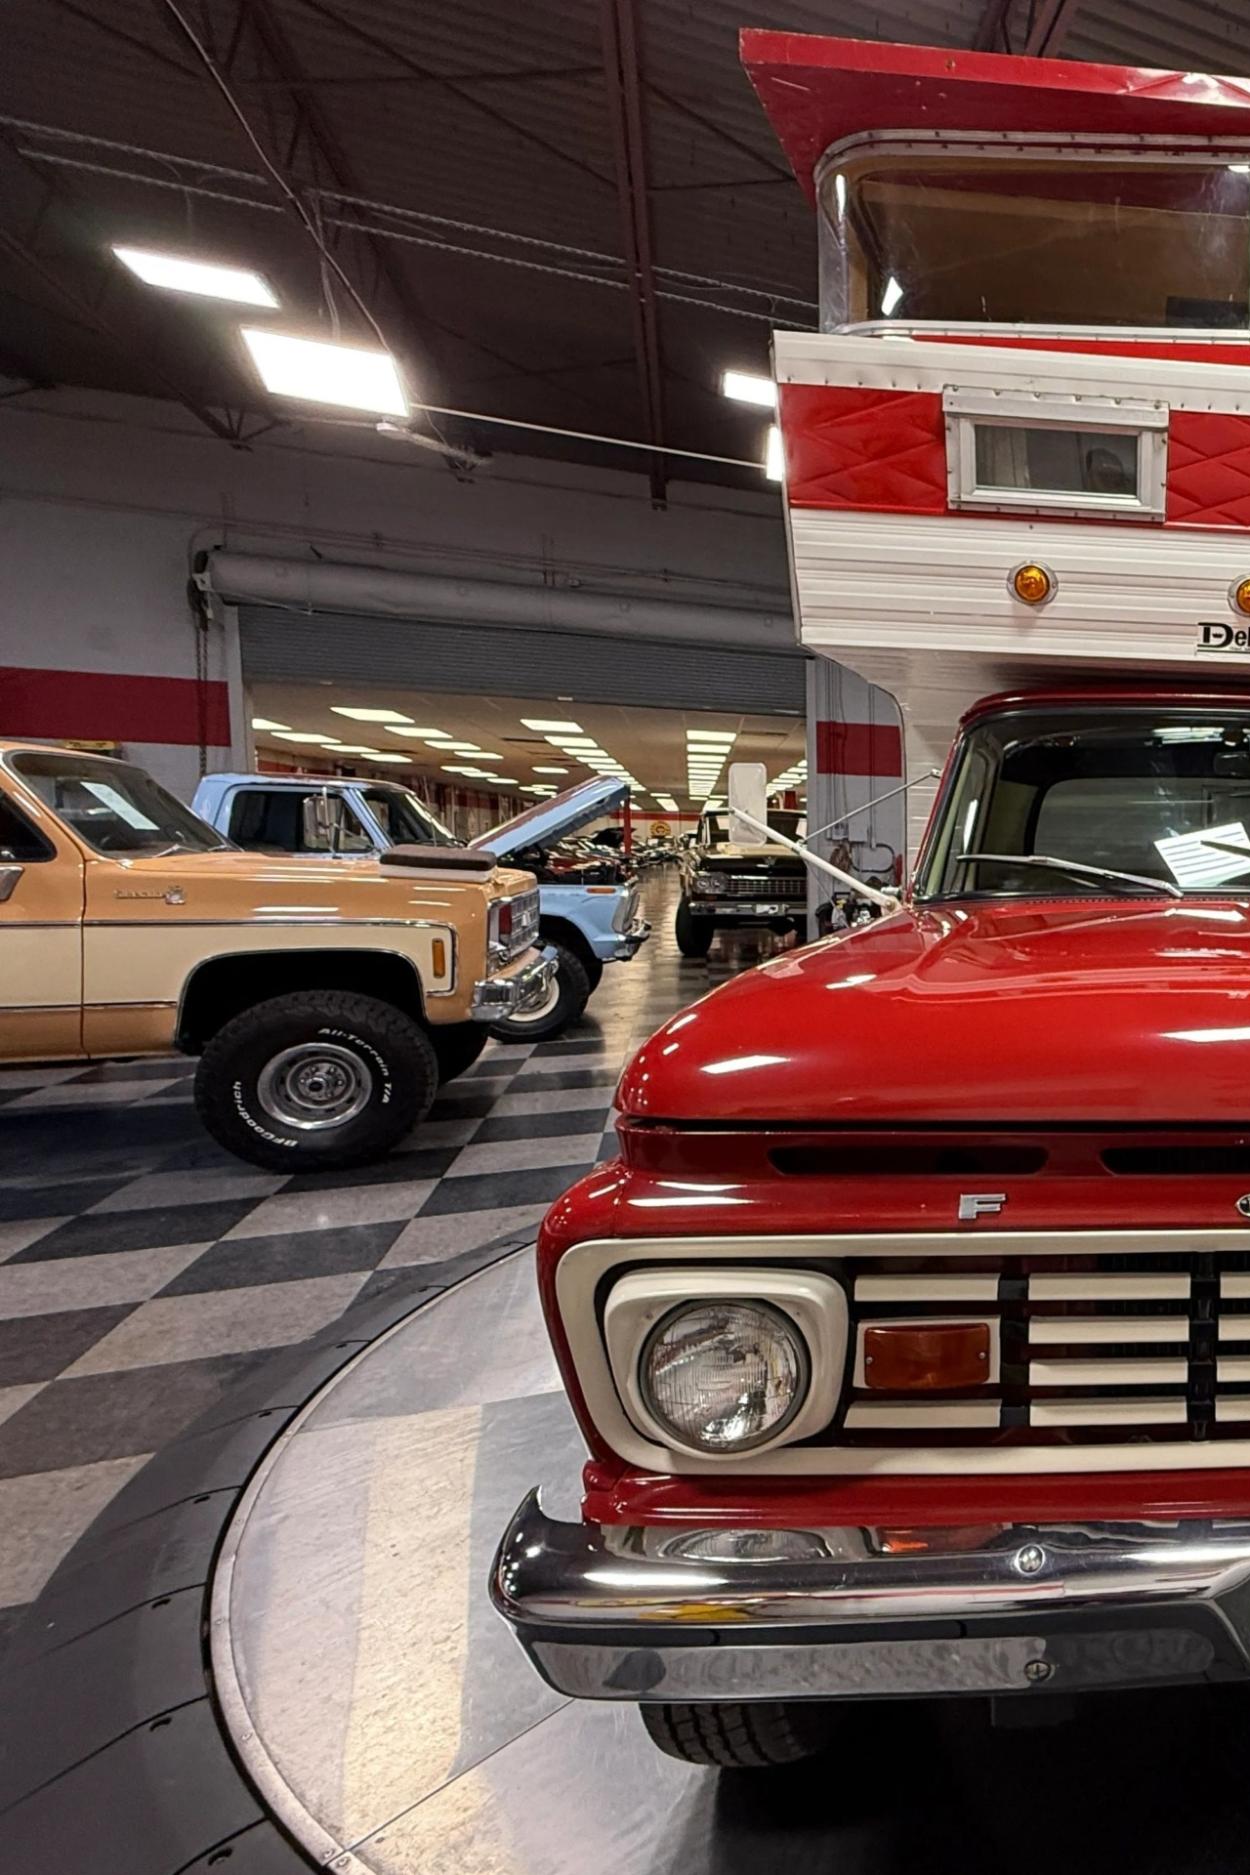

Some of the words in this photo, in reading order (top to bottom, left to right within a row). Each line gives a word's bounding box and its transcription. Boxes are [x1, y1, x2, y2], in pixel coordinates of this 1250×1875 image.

[317, 1027, 390, 1077] All-Terrain
[381, 1082, 393, 1104] T/A
[231, 1080, 299, 1148] BFGoodrich
